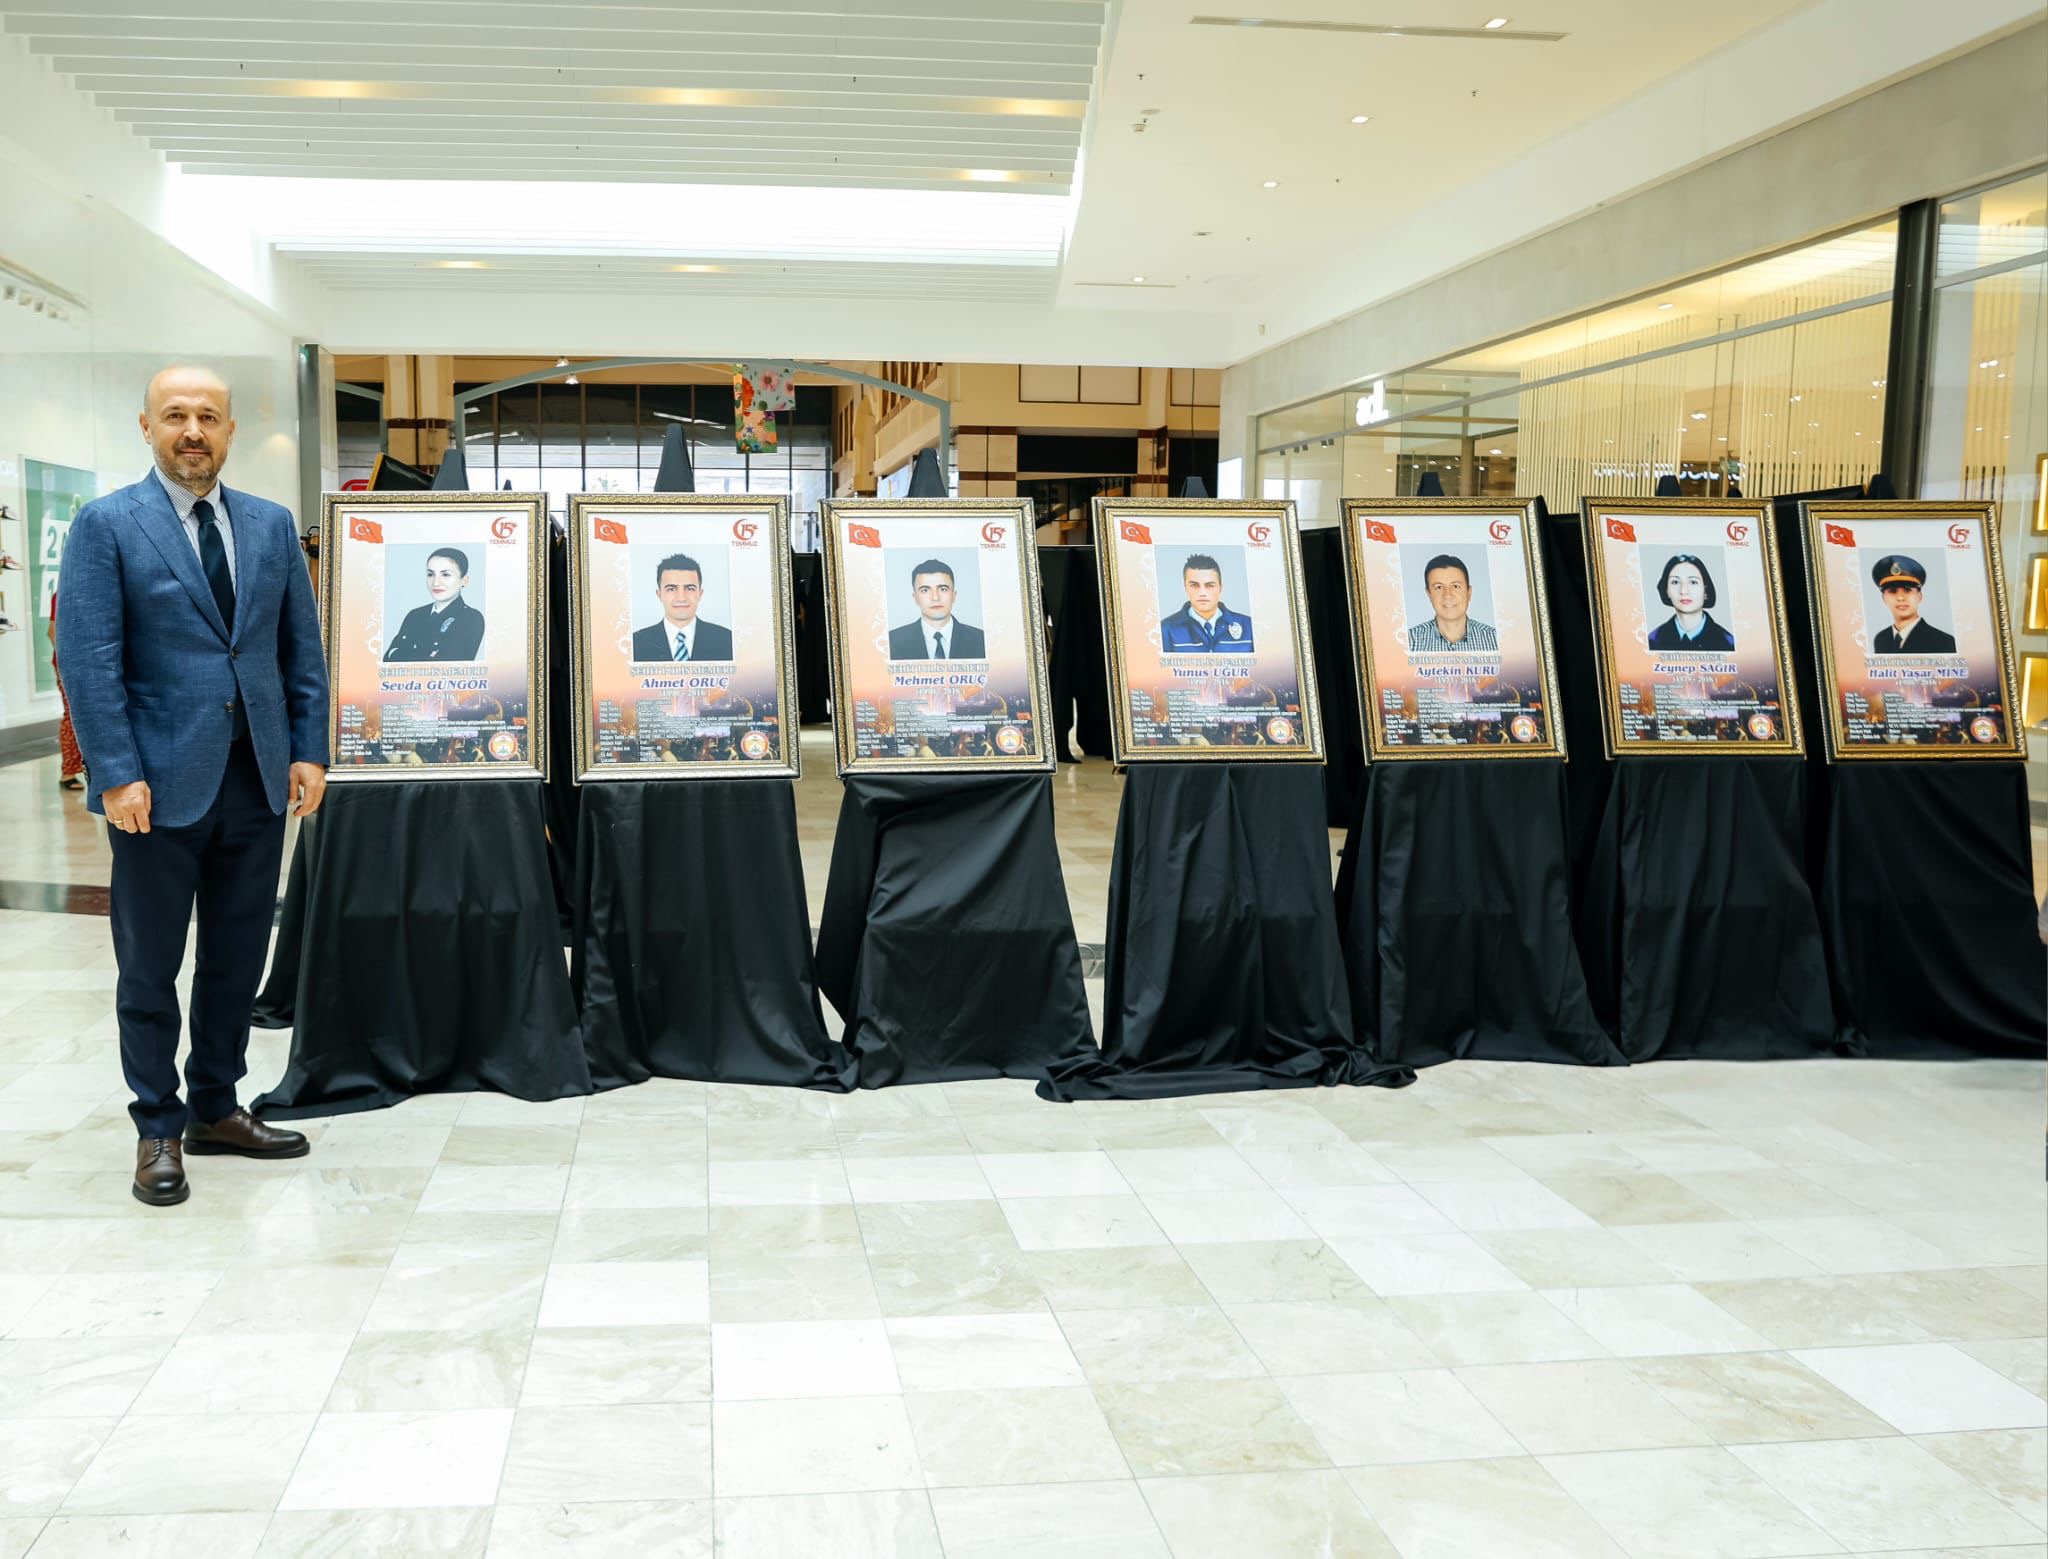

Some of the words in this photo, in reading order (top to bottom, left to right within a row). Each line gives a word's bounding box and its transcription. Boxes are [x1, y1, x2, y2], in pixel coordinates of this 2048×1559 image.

[1173, 668, 1209, 677] Yunus
[1213, 666, 1249, 677] UĞUR
[1416, 666, 1461, 677] Aytekin
[1466, 666, 1499, 675] KURU
[1654, 663, 1695, 674] Zeynep
[1699, 661, 1736, 673] SAĞIR
[1869, 668, 1897, 678] Halit
[1902, 669, 1932, 680] Yaşar
[381, 680, 422, 691] Sevda
[427, 677, 488, 690] GÜNGÖR
[641, 678, 684, 689] Ahmet
[689, 677, 729, 690] ORUÇ
[894, 675, 944, 686] Mehmet
[949, 674, 986, 687] ORUÇ
